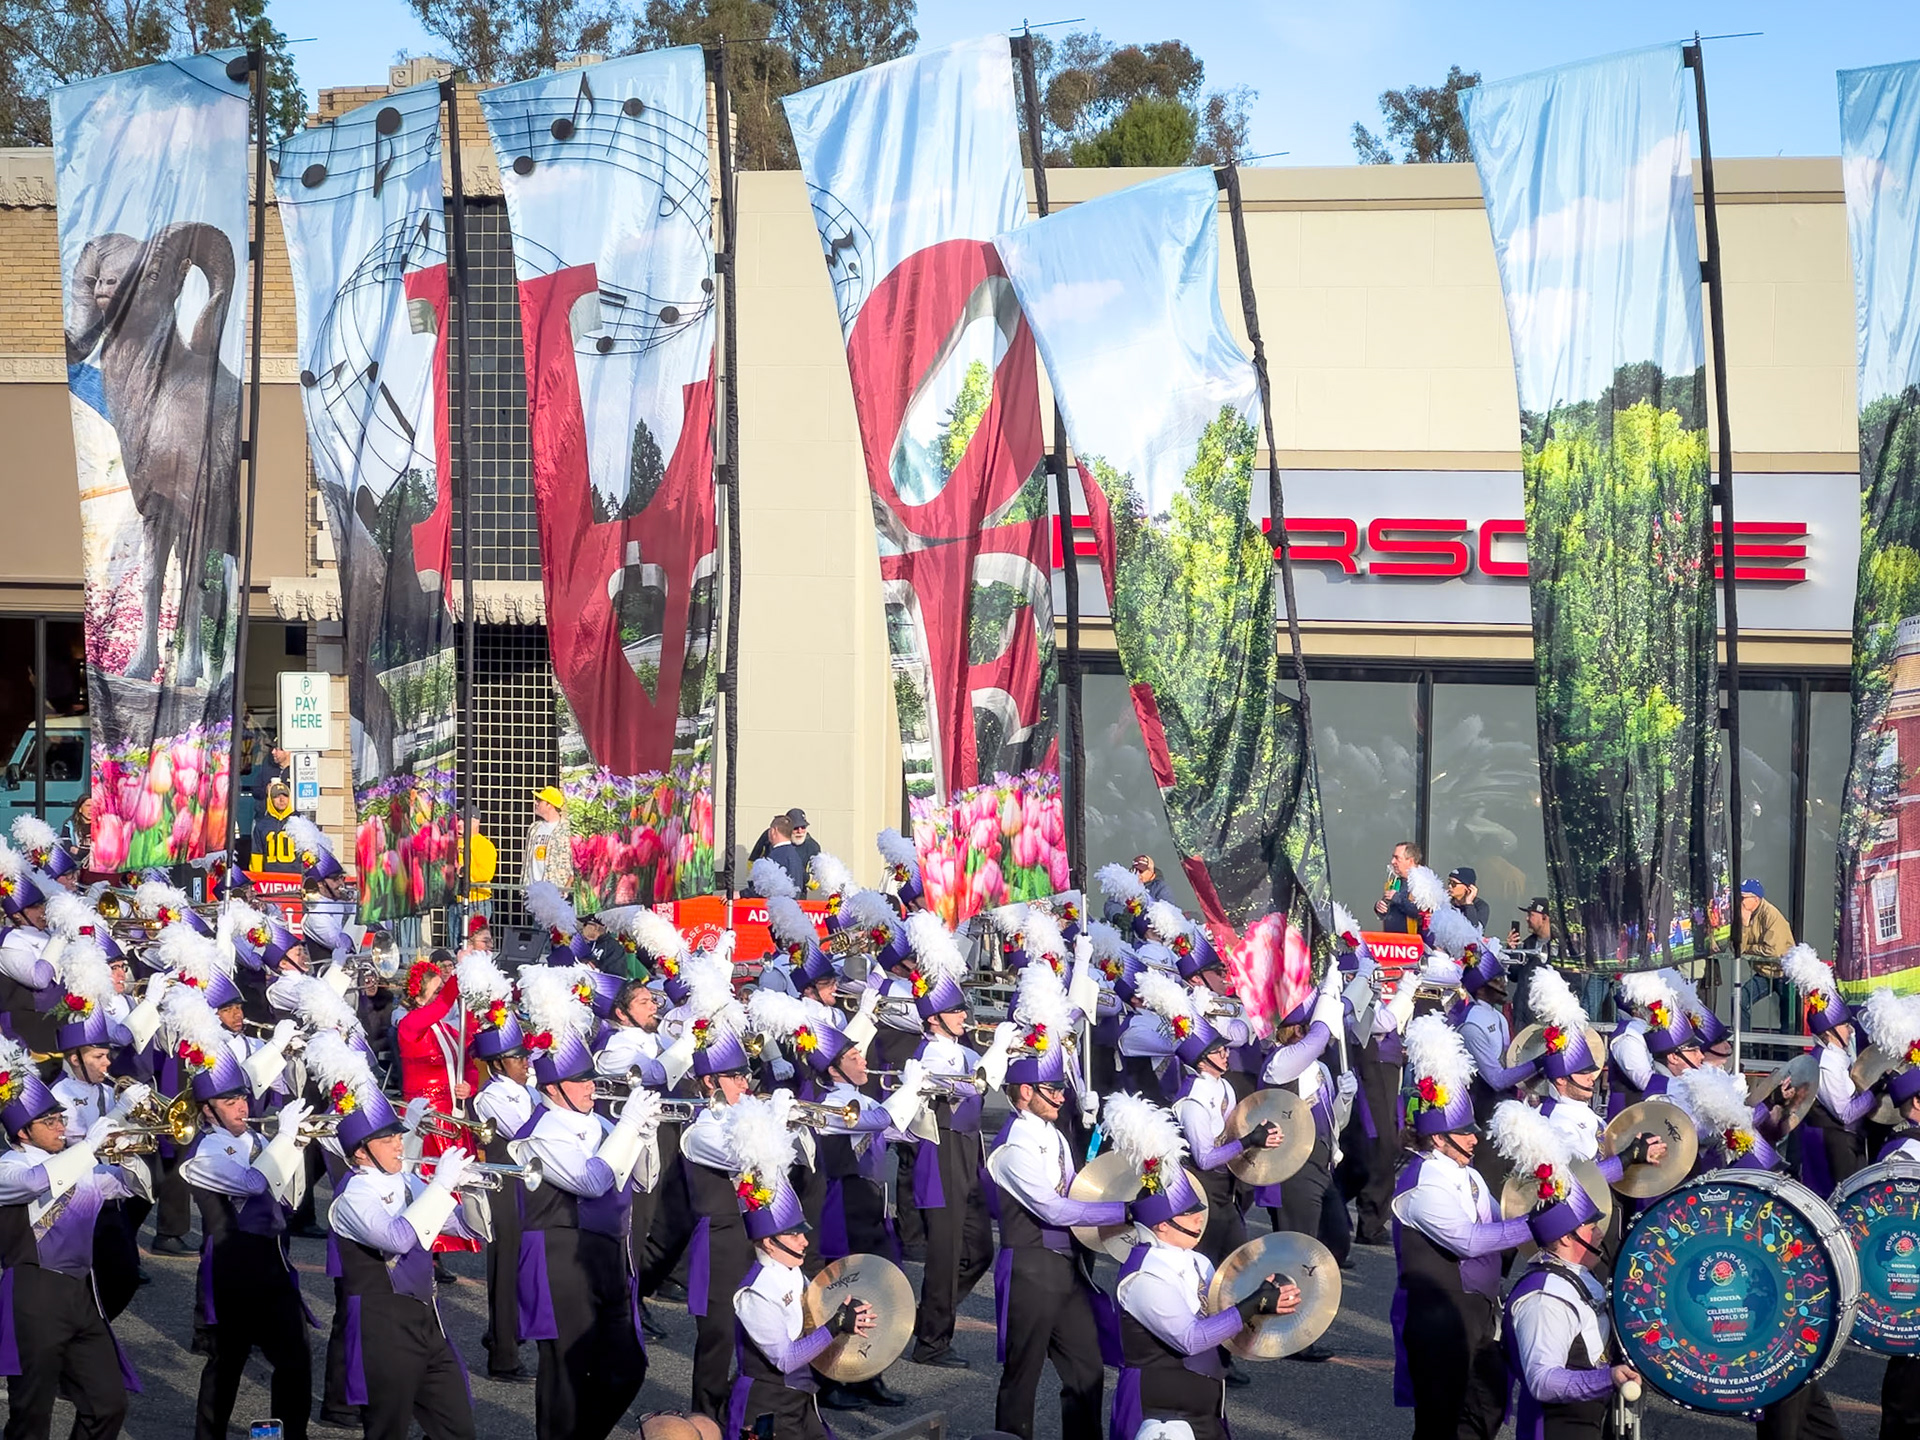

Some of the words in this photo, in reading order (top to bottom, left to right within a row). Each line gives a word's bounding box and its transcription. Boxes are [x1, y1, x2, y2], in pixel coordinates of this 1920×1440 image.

[295, 697, 318, 711] PAY
[291, 714, 322, 728] HERE
[266, 831, 296, 863] 10
[259, 882, 302, 894] VIEW
[748, 910, 769, 922] AD
[704, 923, 725, 934] PAR
[1367, 943, 1419, 960] WING
[1901, 1230, 1920, 1251] PARA
[1698, 1255, 1715, 1281] ROSE
[1716, 1251, 1750, 1277] PARADE
[1709, 1294, 1742, 1302] HONDA
[1706, 1306, 1749, 1315] CELEBRATING
[1670, 1359, 1708, 1382] AMERICA'S
[1708, 1377, 1728, 1385] NEW
[1728, 1376, 1750, 1386] YEAR
[1750, 1350, 1796, 1381] CELEBRATION
[1712, 1387, 1739, 1395] JANUARY
[1744, 1385, 1759, 1393] 2024
